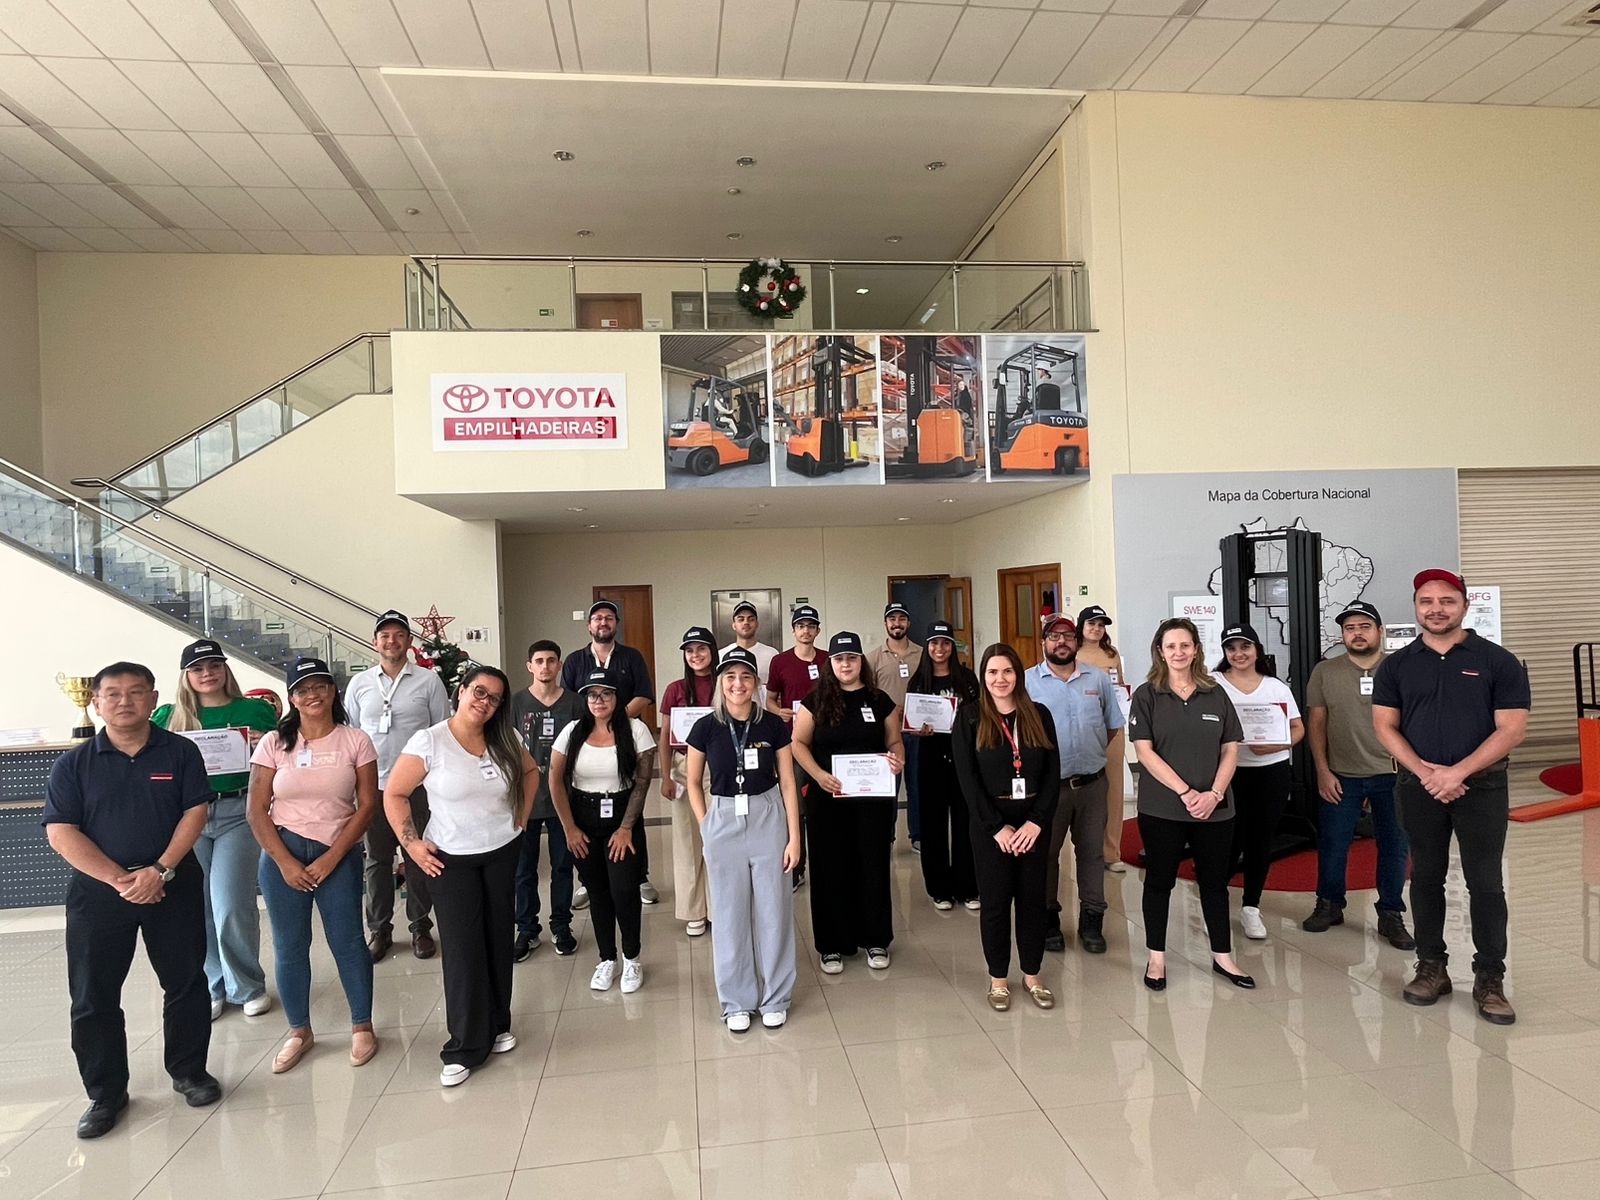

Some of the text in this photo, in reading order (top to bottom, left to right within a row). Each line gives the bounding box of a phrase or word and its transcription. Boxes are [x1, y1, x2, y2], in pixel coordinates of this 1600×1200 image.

[494, 387, 615, 409] TOYOTA
[1050, 416, 1083, 425] TOYOTA
[454, 421, 606, 436] EMPILHADEIRAS
[1208, 488, 1371, 503] Mapa da Cobertura Nacional
[1468, 592, 1491, 601] 8FG
